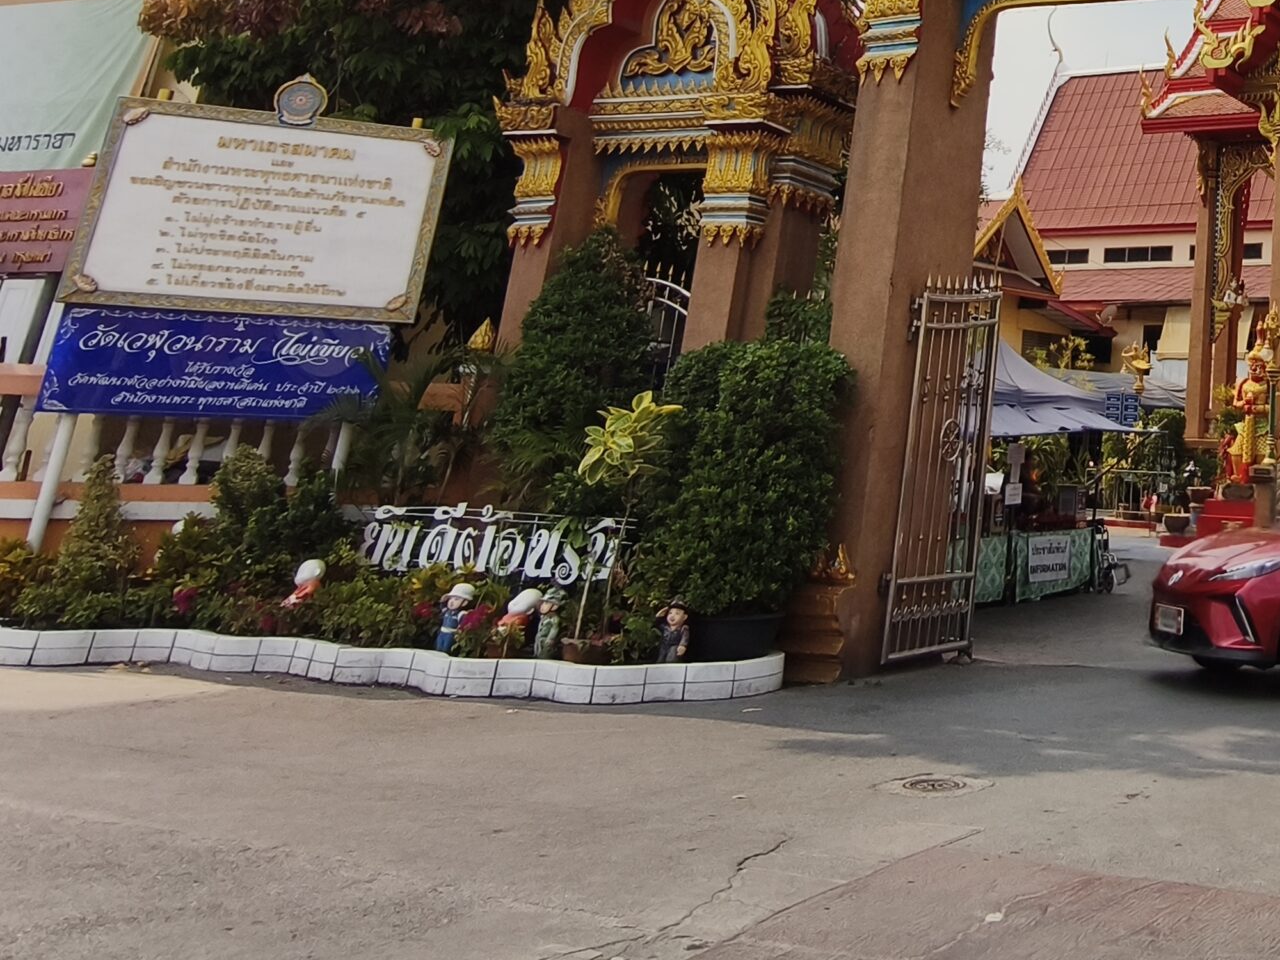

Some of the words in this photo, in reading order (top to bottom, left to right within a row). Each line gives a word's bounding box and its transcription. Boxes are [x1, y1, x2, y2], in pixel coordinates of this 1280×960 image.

[217, 136, 357, 161] มหาเถรสมาคม
